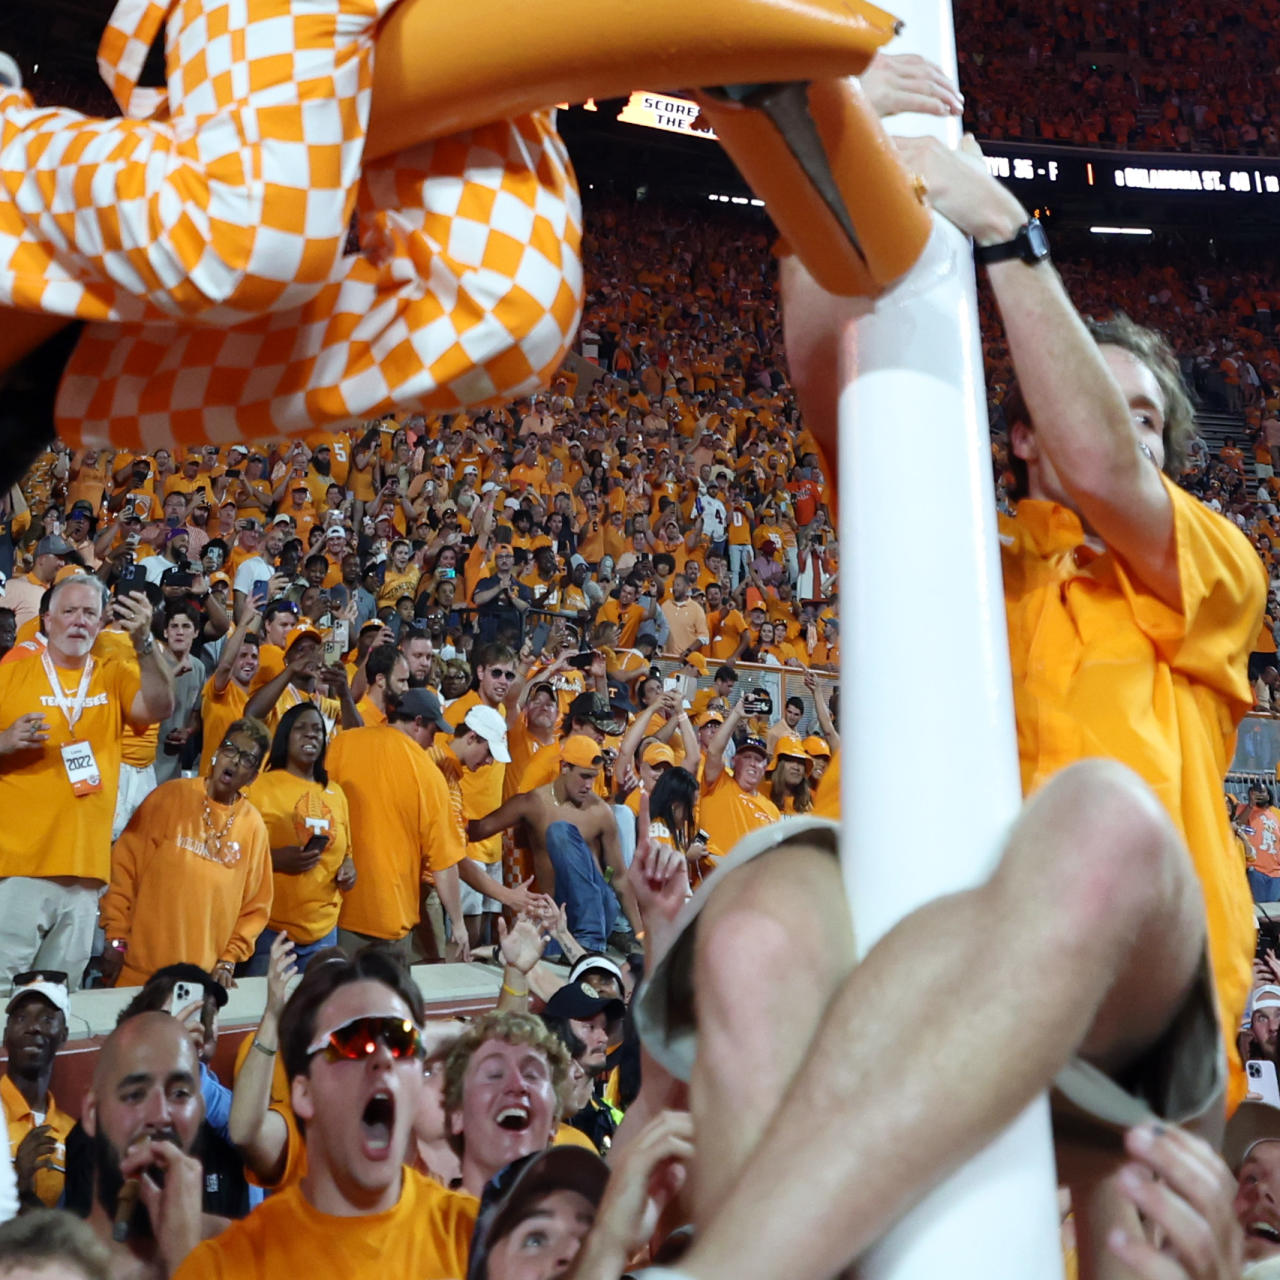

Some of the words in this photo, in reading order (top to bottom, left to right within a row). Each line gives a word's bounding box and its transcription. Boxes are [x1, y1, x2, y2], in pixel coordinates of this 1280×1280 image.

[657, 114, 686, 129] THE
[1048, 161, 1058, 181] F
[1202, 170, 1226, 191] ST.
[333, 443, 347, 462] 5
[66, 755, 93, 771] 2022
